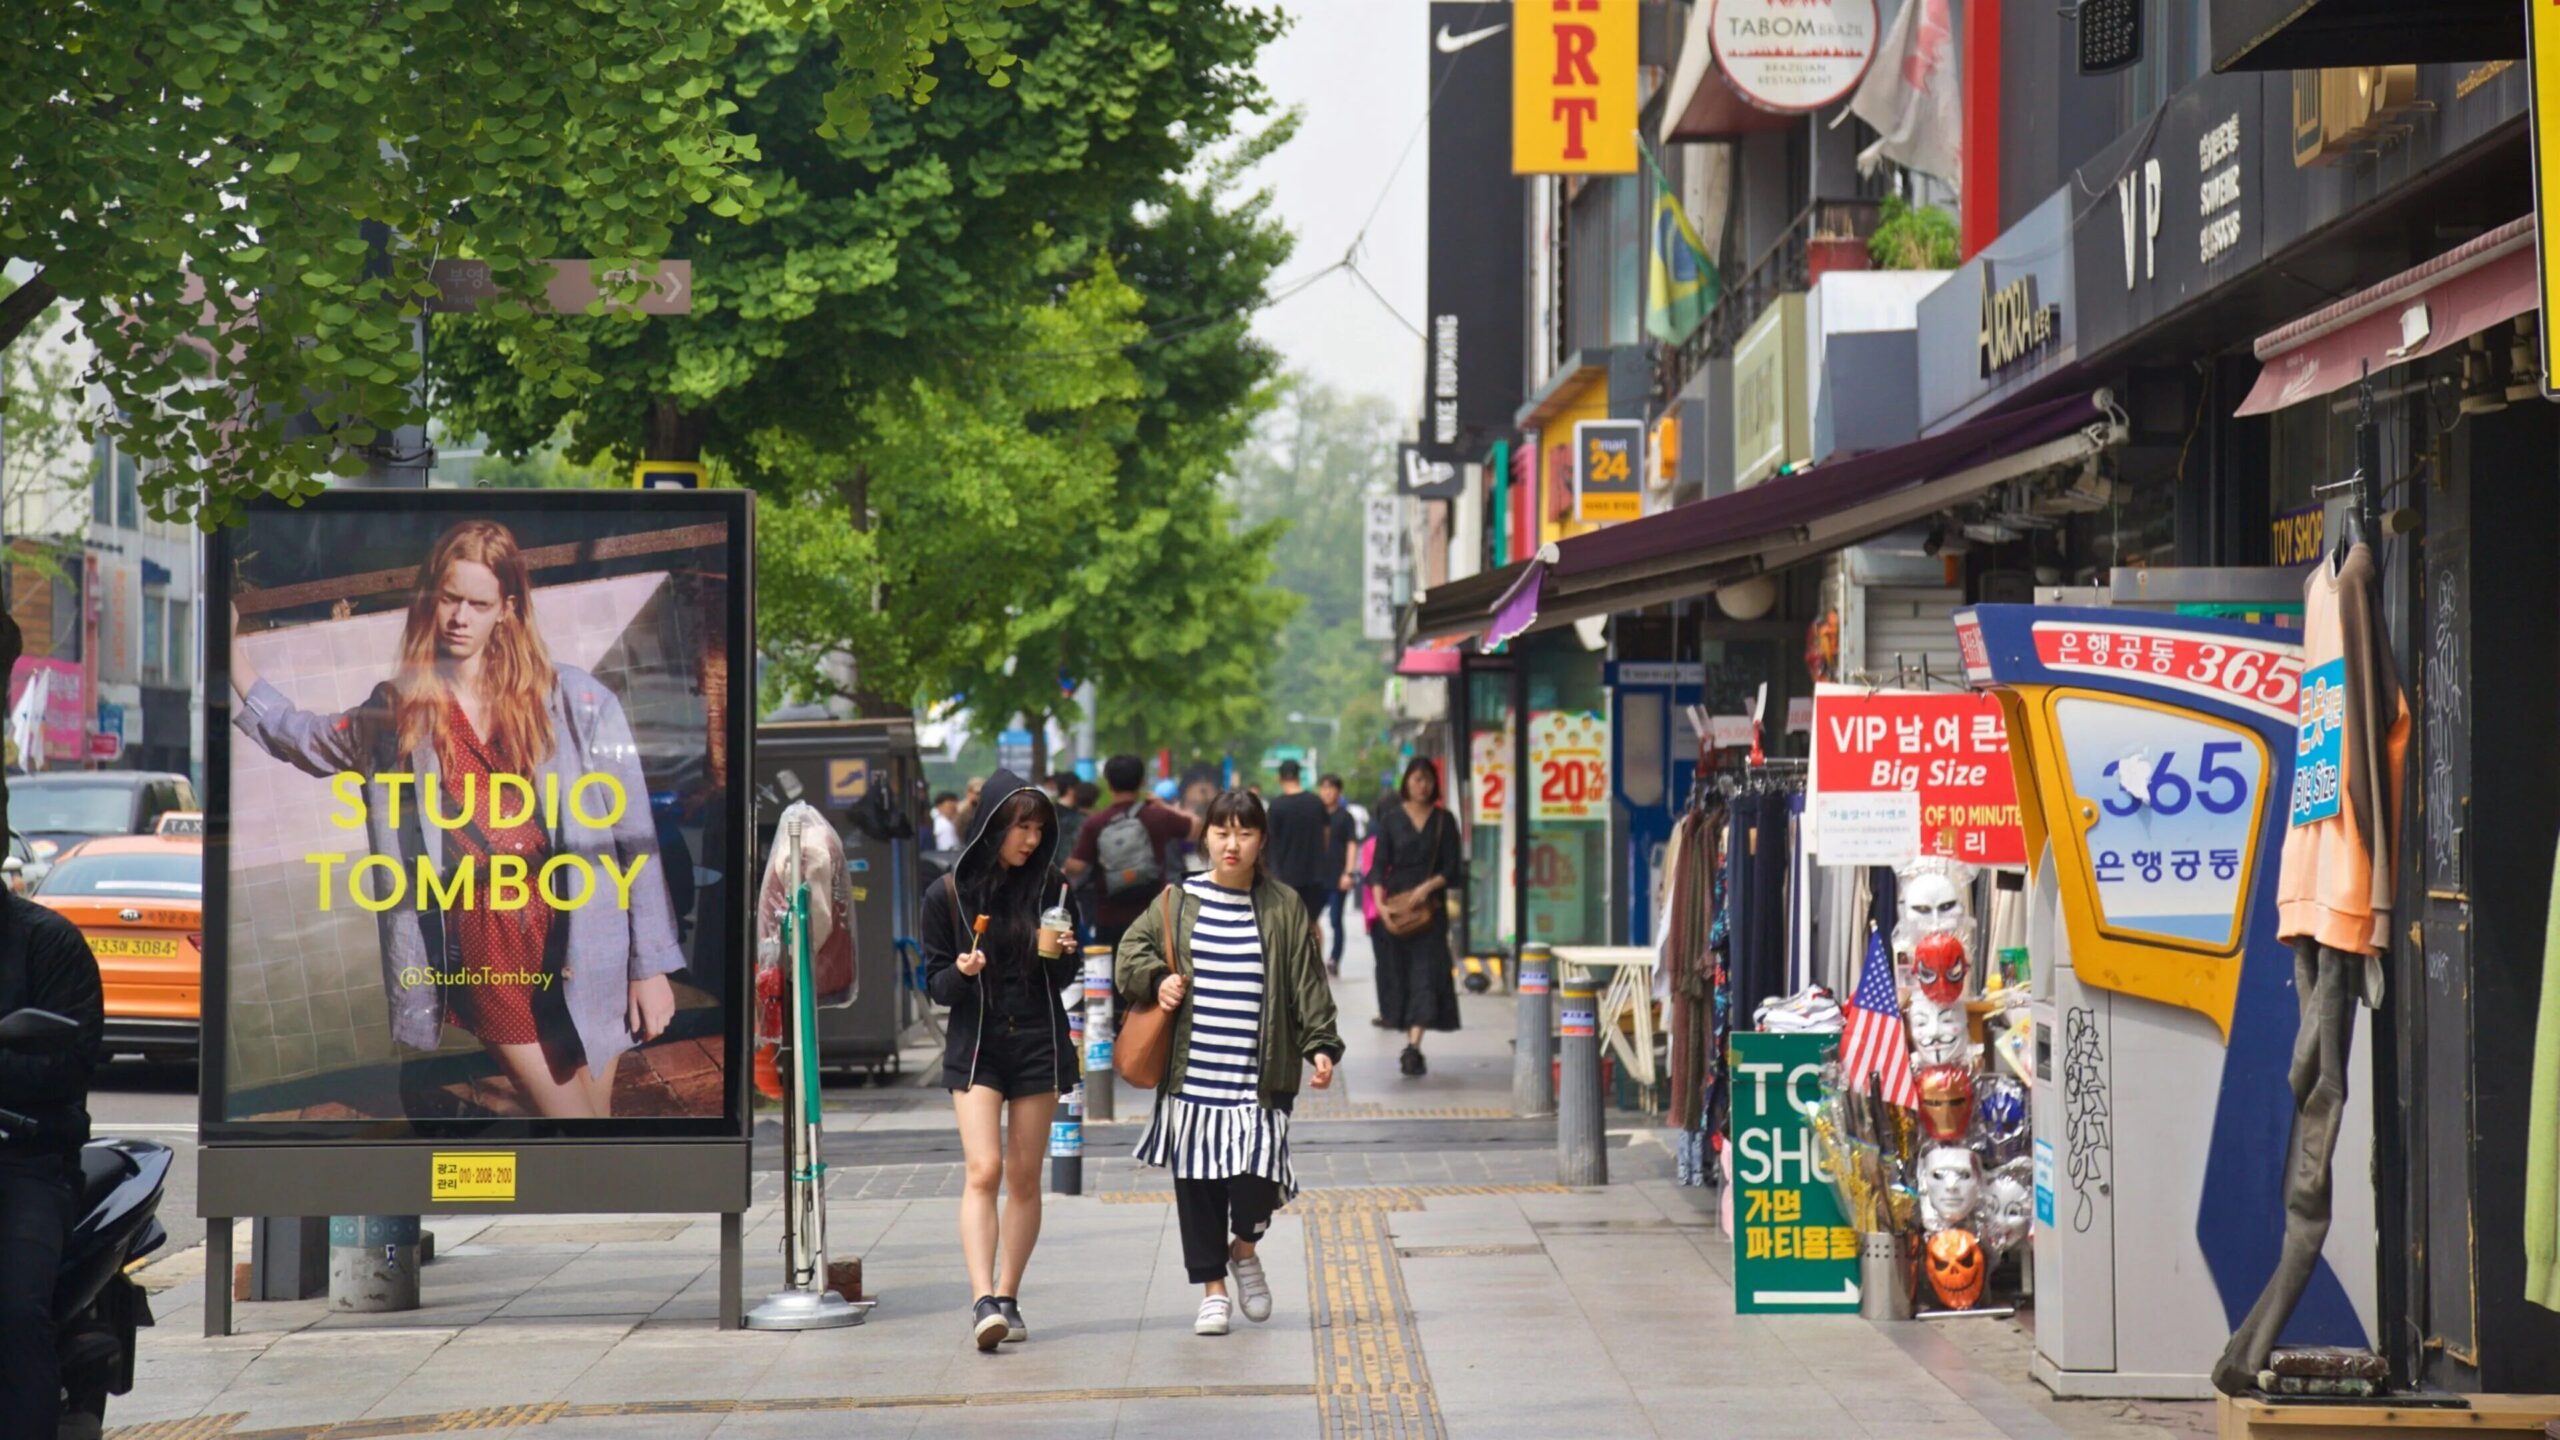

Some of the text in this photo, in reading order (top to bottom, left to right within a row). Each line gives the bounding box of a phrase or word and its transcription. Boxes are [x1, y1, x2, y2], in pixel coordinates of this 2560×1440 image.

[1729, 17, 1864, 36] TABOM BRAZIL
[1552, 0, 1600, 160] RT
[1758, 75, 1832, 85] RESTAURANT
[1765, 63, 1826, 72] BRAZILIAN
[1979, 260, 2034, 373] AURORA
[1435, 315, 1458, 444] NIKE RUNNING
[1590, 449, 1631, 482] 24
[2272, 510, 2324, 567] TOY SHOP
[2058, 632, 2306, 705] 은행공동 365
[1830, 715, 2009, 753] VIP 남.여 큰
[1871, 759, 1987, 792] Big Size
[2294, 758, 2337, 816] Big Size
[330, 770, 627, 830] STUDIO
[1925, 805, 1946, 827] OF
[1949, 805, 1966, 827] 10
[305, 853, 649, 912] TOMBOY
[2095, 849, 2239, 883] 은행공동
[131, 940, 173, 955] 3084
[400, 966, 554, 991] @StudioTomboy
[437, 1163, 457, 1174] 광고
[437, 1179, 457, 1190] 관리
[1744, 1189, 1801, 1222] 가면
[1746, 1226, 1859, 1259] 파티용품
